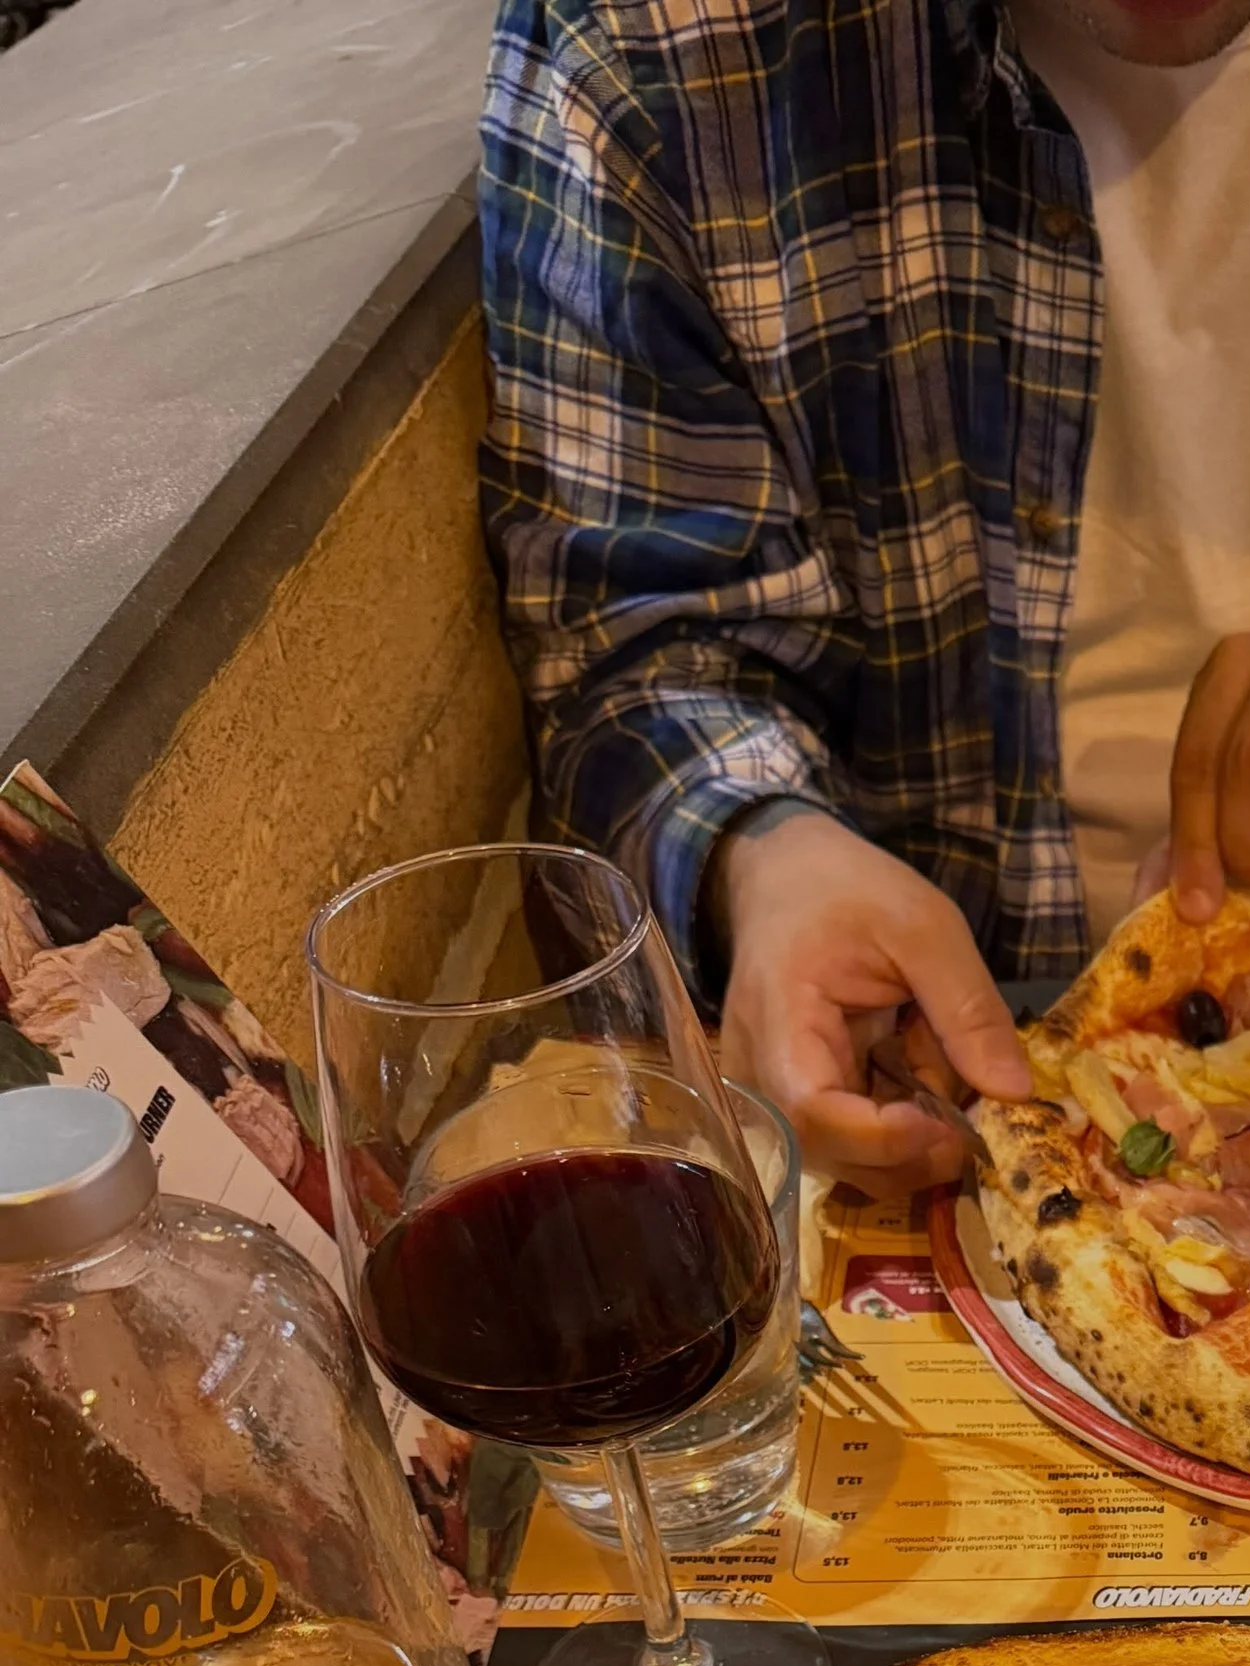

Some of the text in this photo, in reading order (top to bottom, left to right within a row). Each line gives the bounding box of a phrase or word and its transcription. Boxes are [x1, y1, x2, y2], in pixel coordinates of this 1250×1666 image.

[1058, 1504, 1164, 1515] Prosciutto crudo
[1107, 1551, 1163, 1560] Ortolana
[670, 1556, 716, 1565] Nutella
[744, 1556, 776, 1565] Pizza
